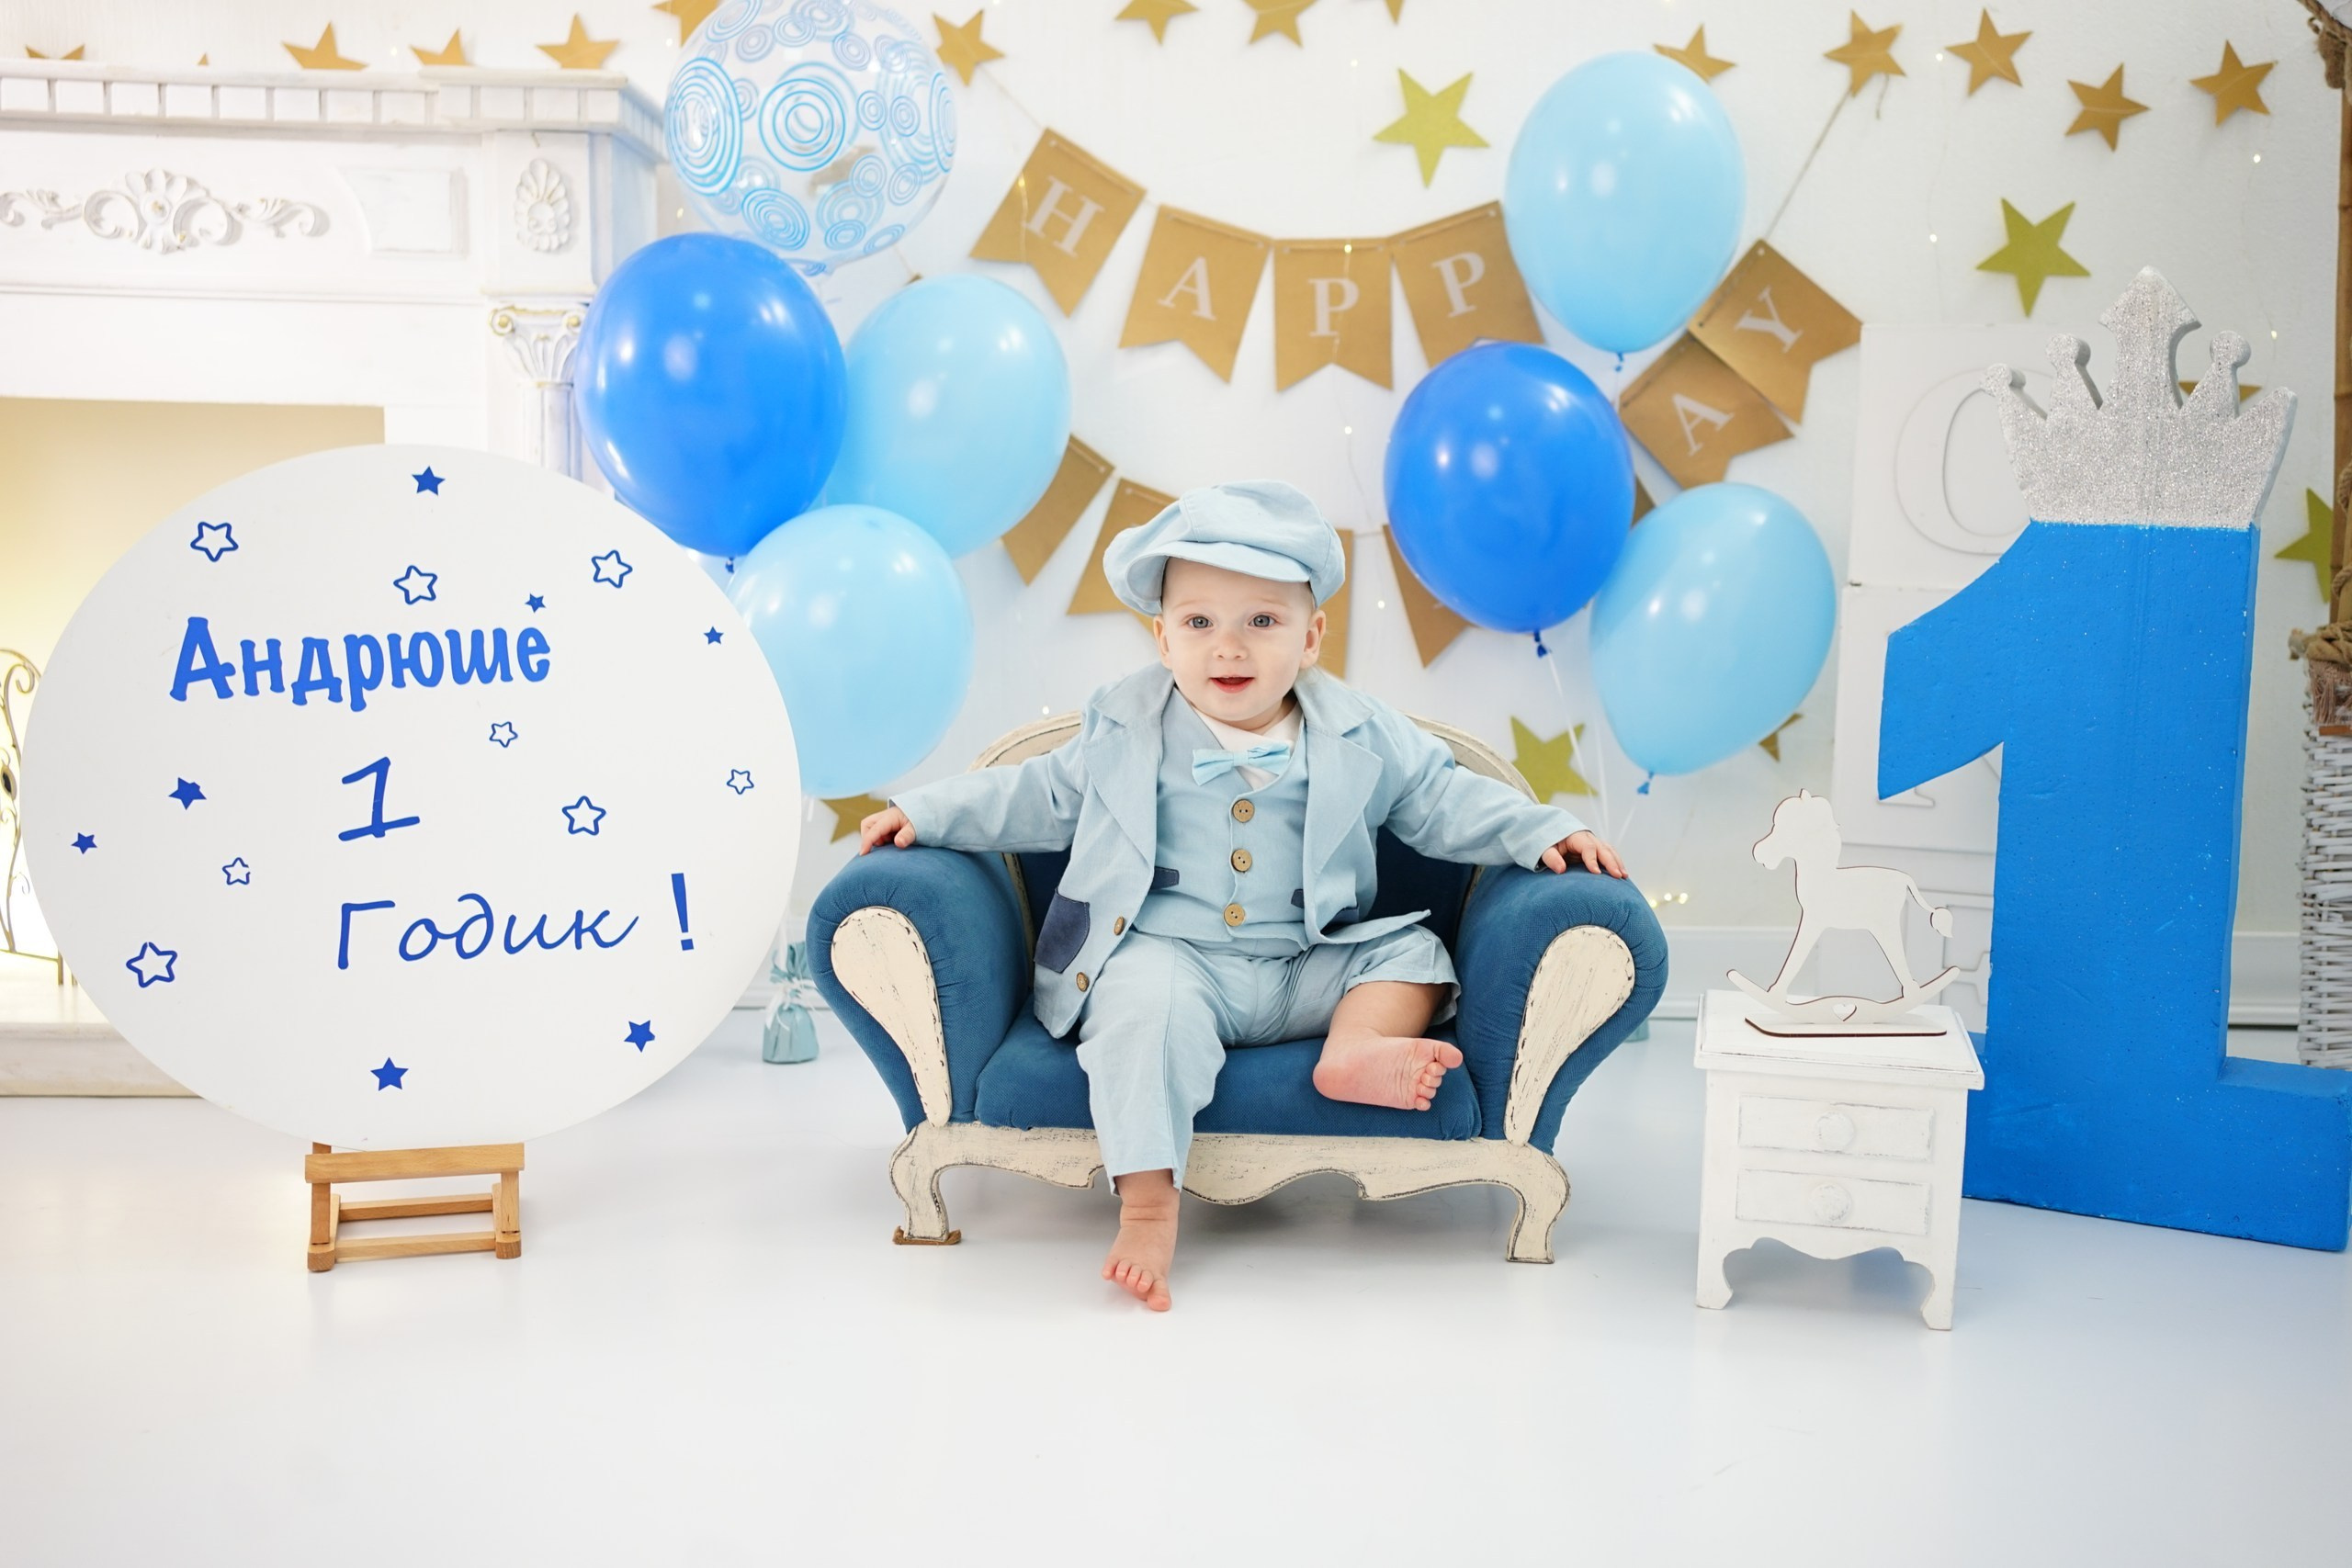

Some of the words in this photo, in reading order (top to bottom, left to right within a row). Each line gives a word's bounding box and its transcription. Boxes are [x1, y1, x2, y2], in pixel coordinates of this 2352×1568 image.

[1022, 175, 1487, 338] HAPP
[169, 615, 551, 713] Андрюше
[337, 756, 421, 842] 1
